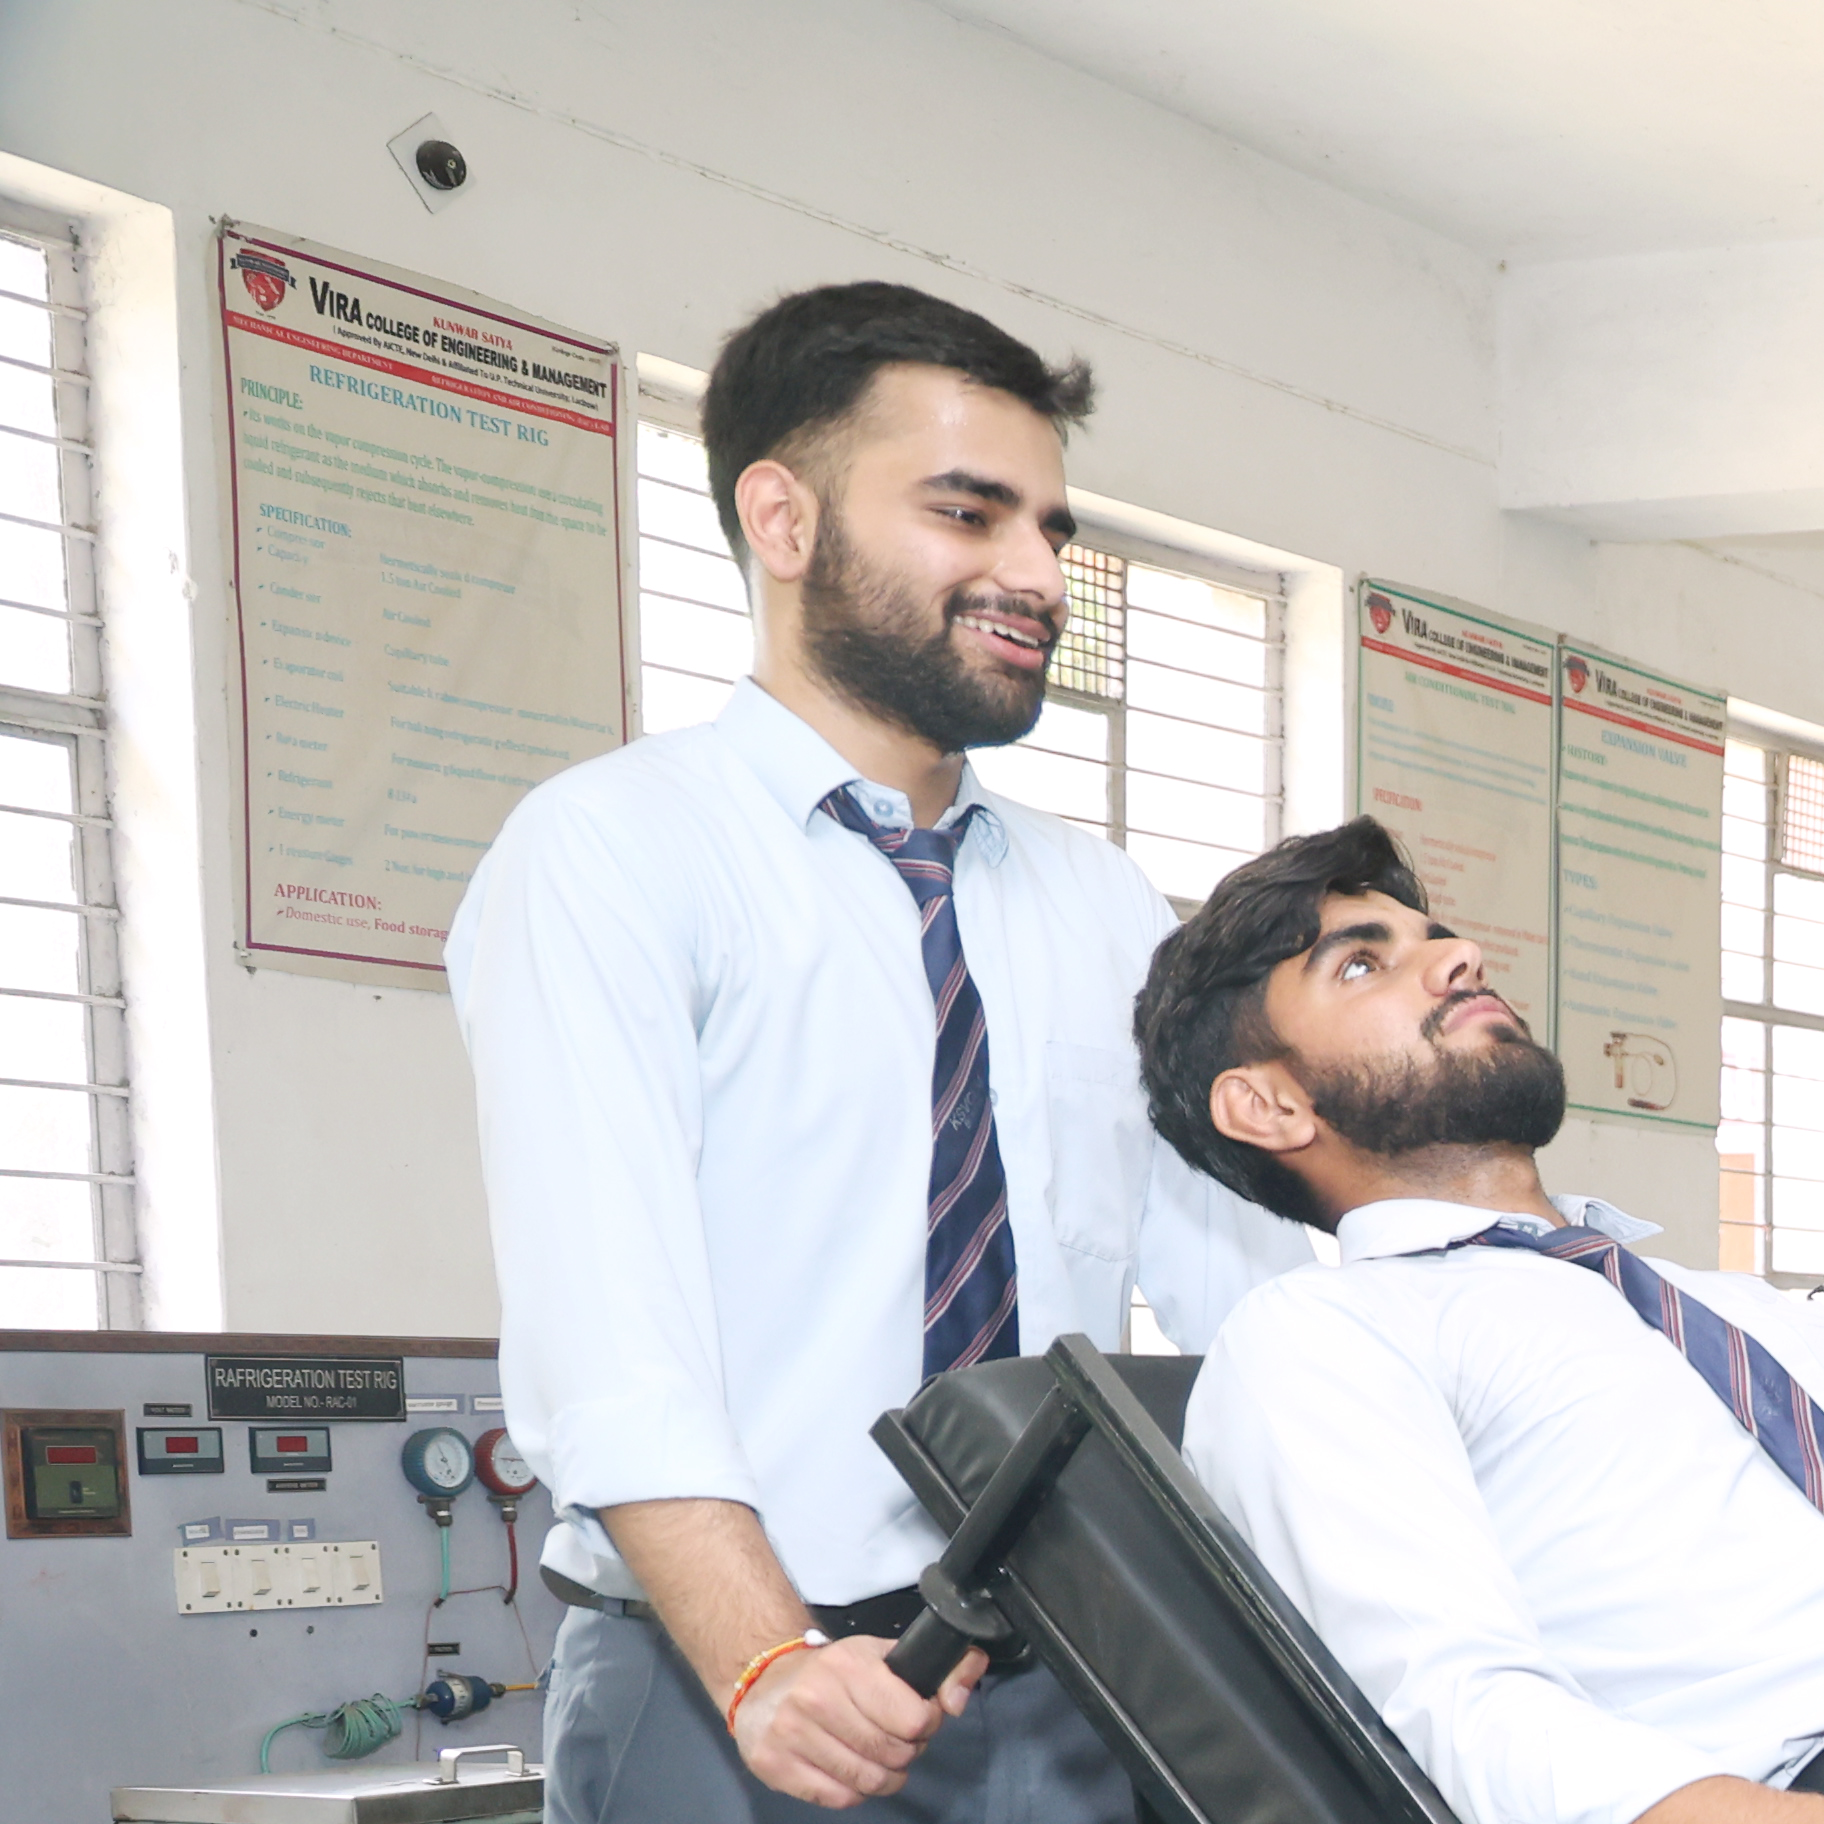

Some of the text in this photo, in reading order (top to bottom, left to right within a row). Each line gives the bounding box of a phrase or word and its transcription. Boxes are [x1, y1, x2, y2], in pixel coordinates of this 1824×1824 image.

[309, 276, 607, 398] VIRA COLLEGE OF ENGINEERING & MANAGEMENT
[433, 317, 513, 350] KUNWAR SATYA
[241, 378, 303, 410] PRINCIPLE:
[504, 375, 534, 392] Technical
[310, 365, 549, 446] REFRIGERATION TEST RIG
[259, 503, 352, 538] SPECIFICATION:
[274, 883, 382, 911] APPLICATION:
[286, 907, 449, 942] Domestic use, Food storag
[215, 1368, 397, 1389] RAFRIGERATION TEST RIG
[266, 1395, 302, 1408] MODEL
